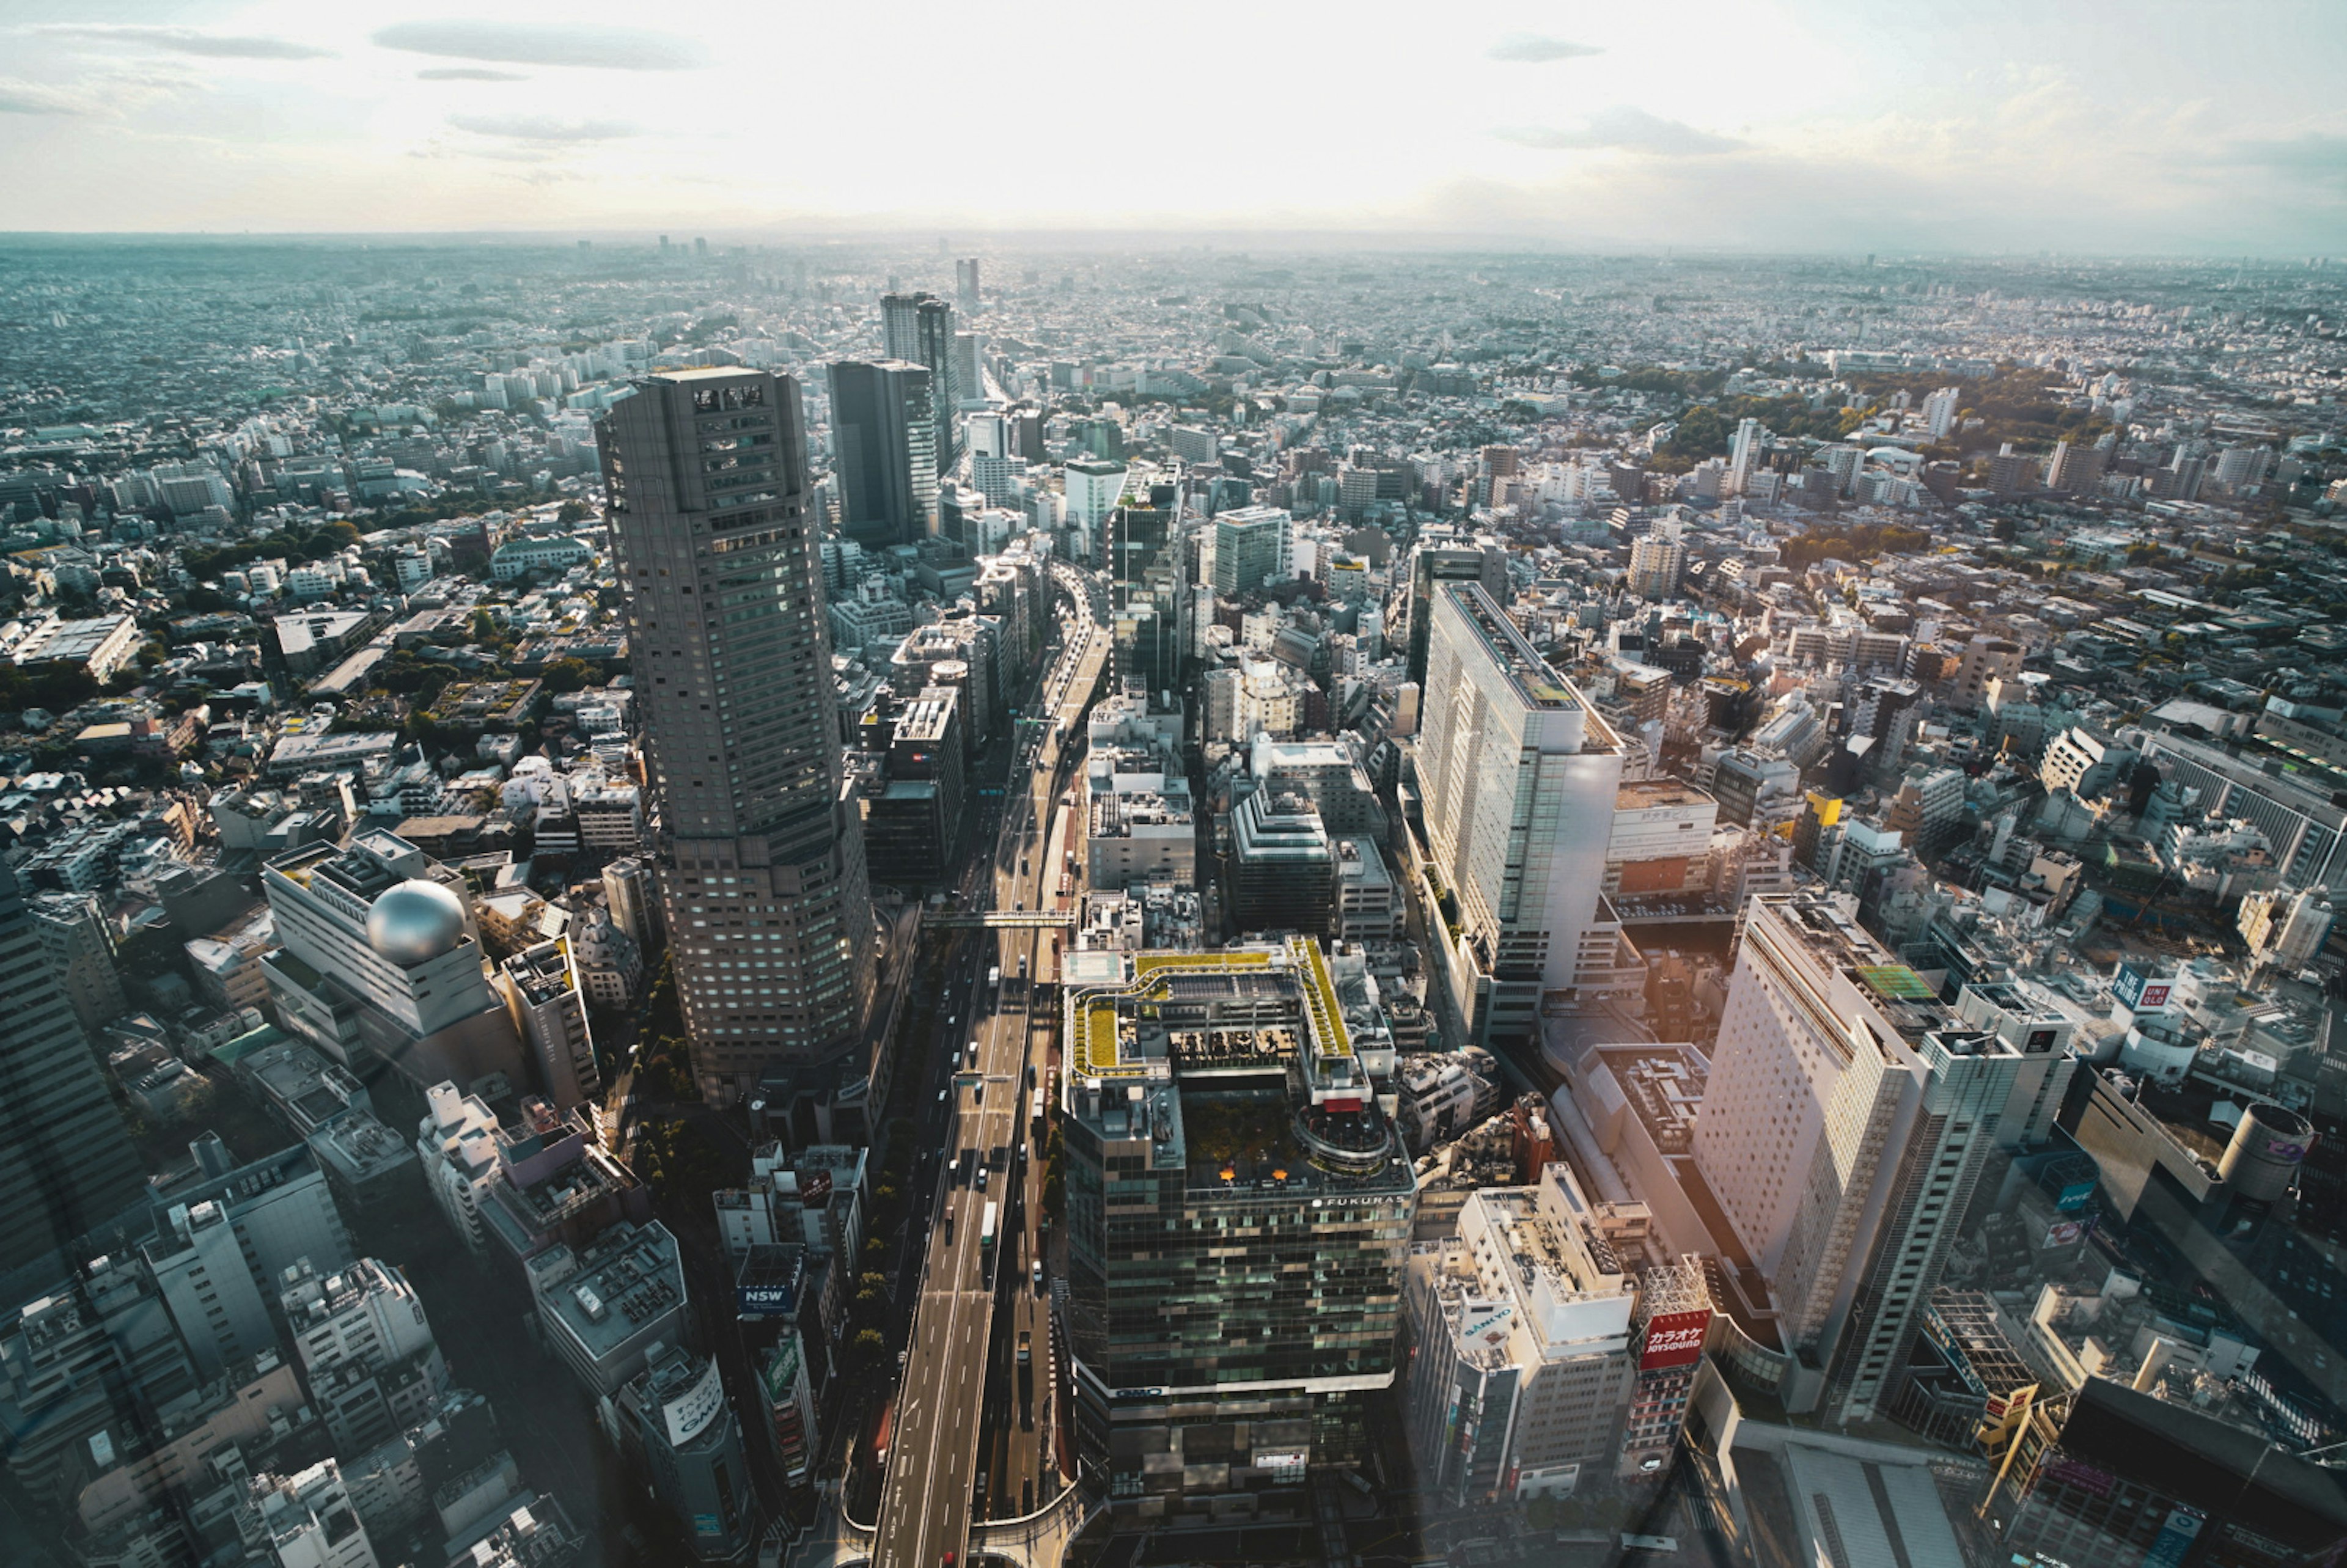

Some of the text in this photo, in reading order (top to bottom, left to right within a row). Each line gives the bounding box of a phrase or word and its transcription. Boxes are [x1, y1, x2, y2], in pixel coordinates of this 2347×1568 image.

[2125, 971, 2139, 991] THE
[2114, 980, 2137, 1005] PRIME
[1327, 1196, 1405, 1206] FUKURAS
[746, 1291, 783, 1302] NSW
[1464, 1309, 1511, 1337] SANKYO
[1650, 1328, 1703, 1345] カラオケ
[680, 1388, 720, 1432] GMO
